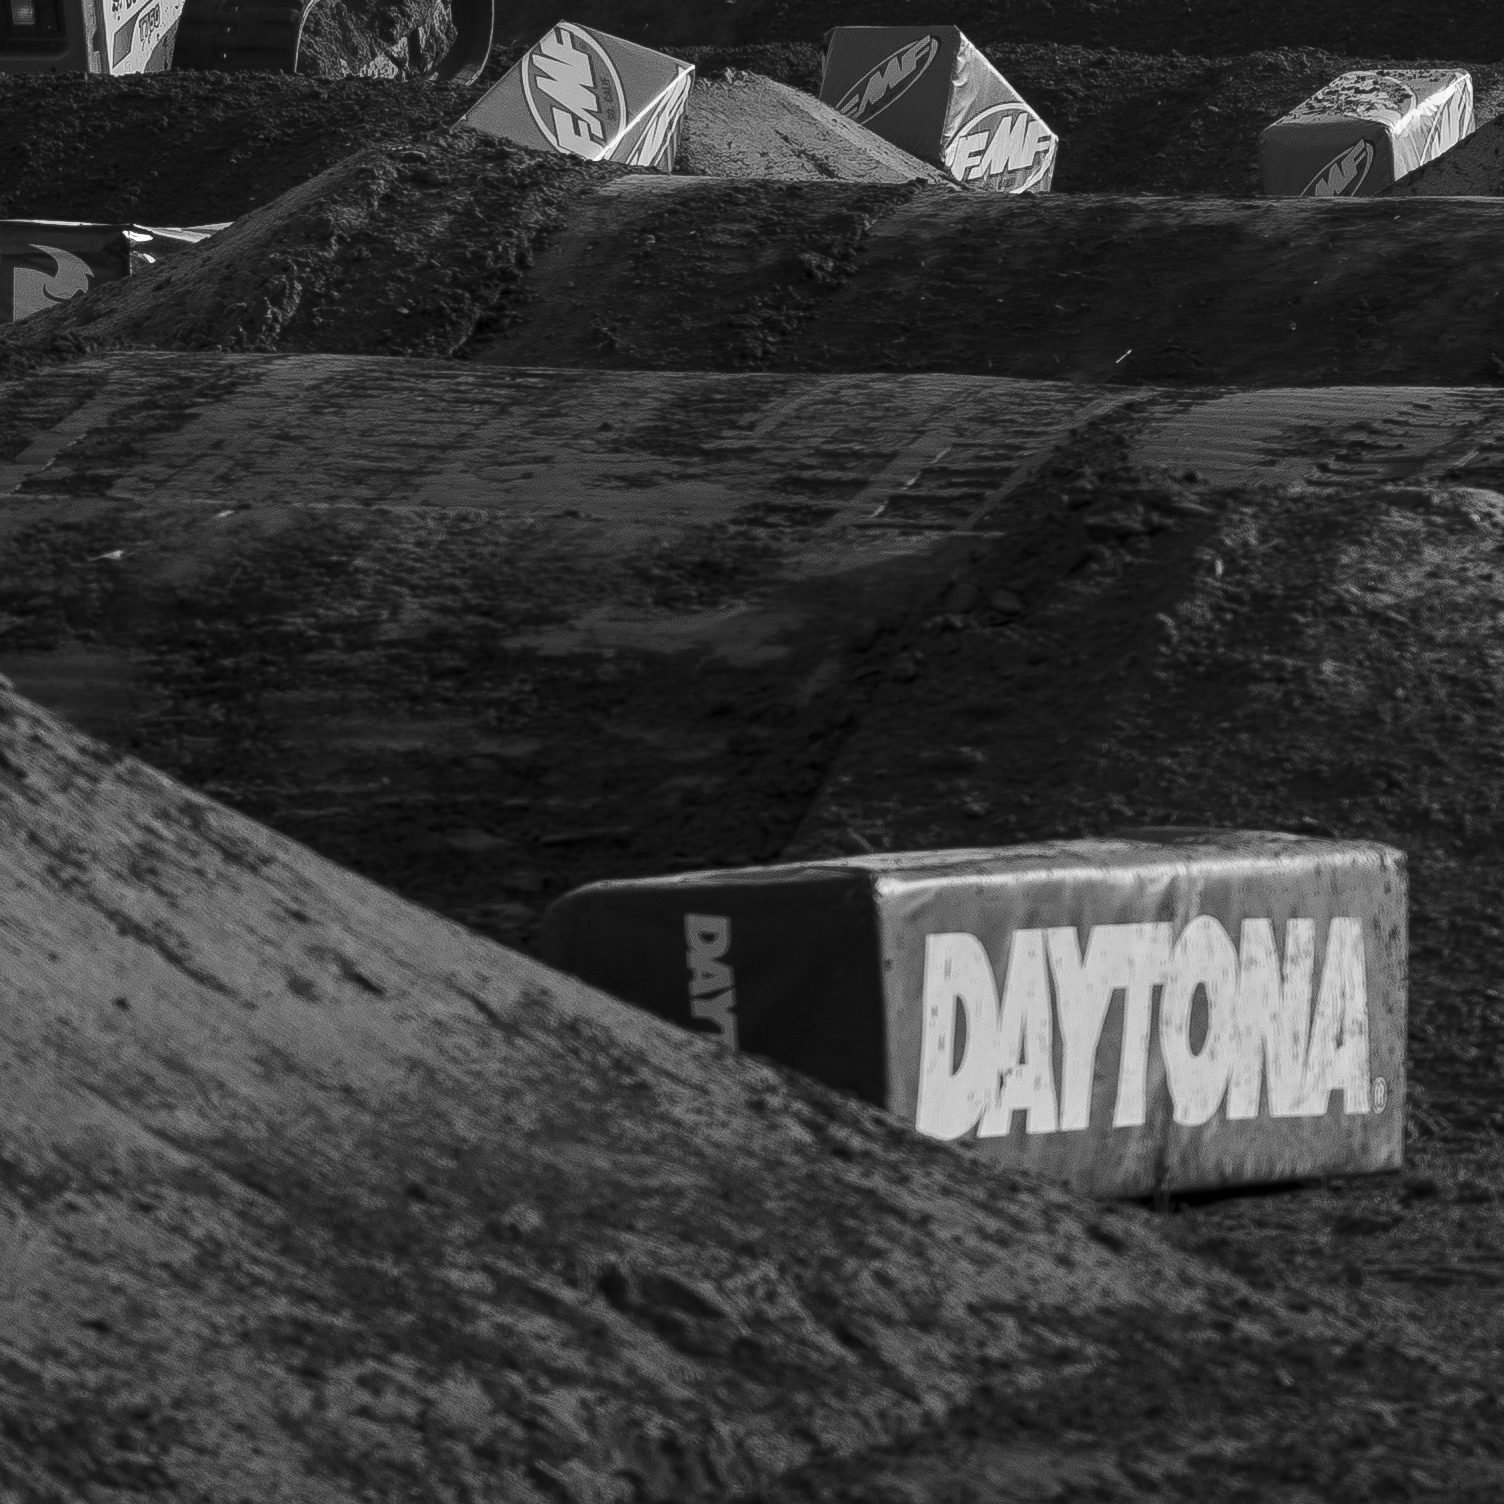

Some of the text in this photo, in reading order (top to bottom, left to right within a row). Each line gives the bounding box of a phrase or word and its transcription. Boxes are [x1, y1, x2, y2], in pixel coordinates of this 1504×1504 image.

[950, 113, 1051, 182] FMF
[1314, 138, 1370, 196] MF
[916, 914, 1371, 1141] DAYTONA
